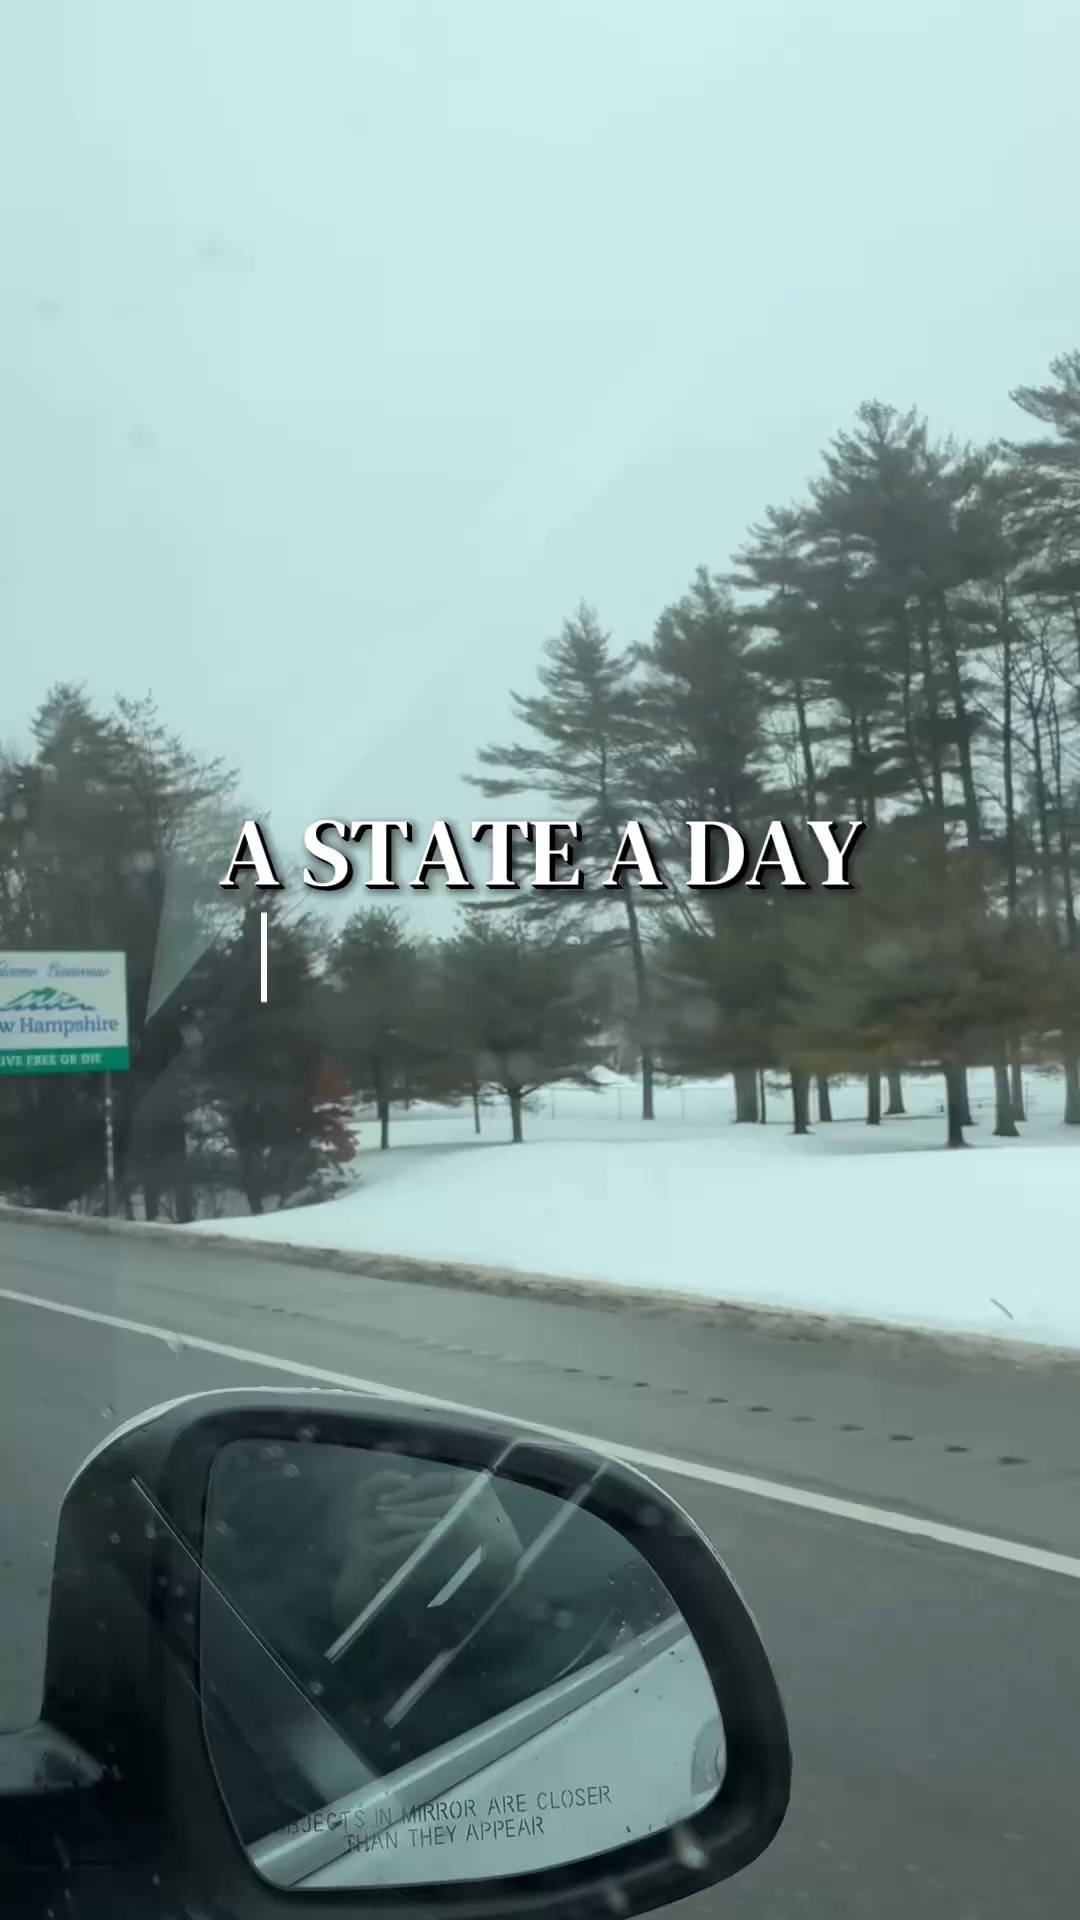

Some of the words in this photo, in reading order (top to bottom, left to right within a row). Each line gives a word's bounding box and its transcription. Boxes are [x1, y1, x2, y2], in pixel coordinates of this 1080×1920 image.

[20, 1014, 120, 1038] Hampshire
[0, 1055, 23, 1066] IVE
[26, 1054, 57, 1066] FREE
[60, 1054, 78, 1065] OR
[81, 1053, 103, 1064] DIE
[283, 1808, 366, 1834] BJECTS
[375, 1806, 393, 1828] IN
[402, 1800, 476, 1823] MIRROR
[487, 1795, 526, 1817] ARE
[537, 1785, 612, 1811] CLOSER
[345, 1832, 399, 1854] THAN
[408, 1825, 458, 1848] THEY
[466, 1816, 545, 1842] APPEAR
